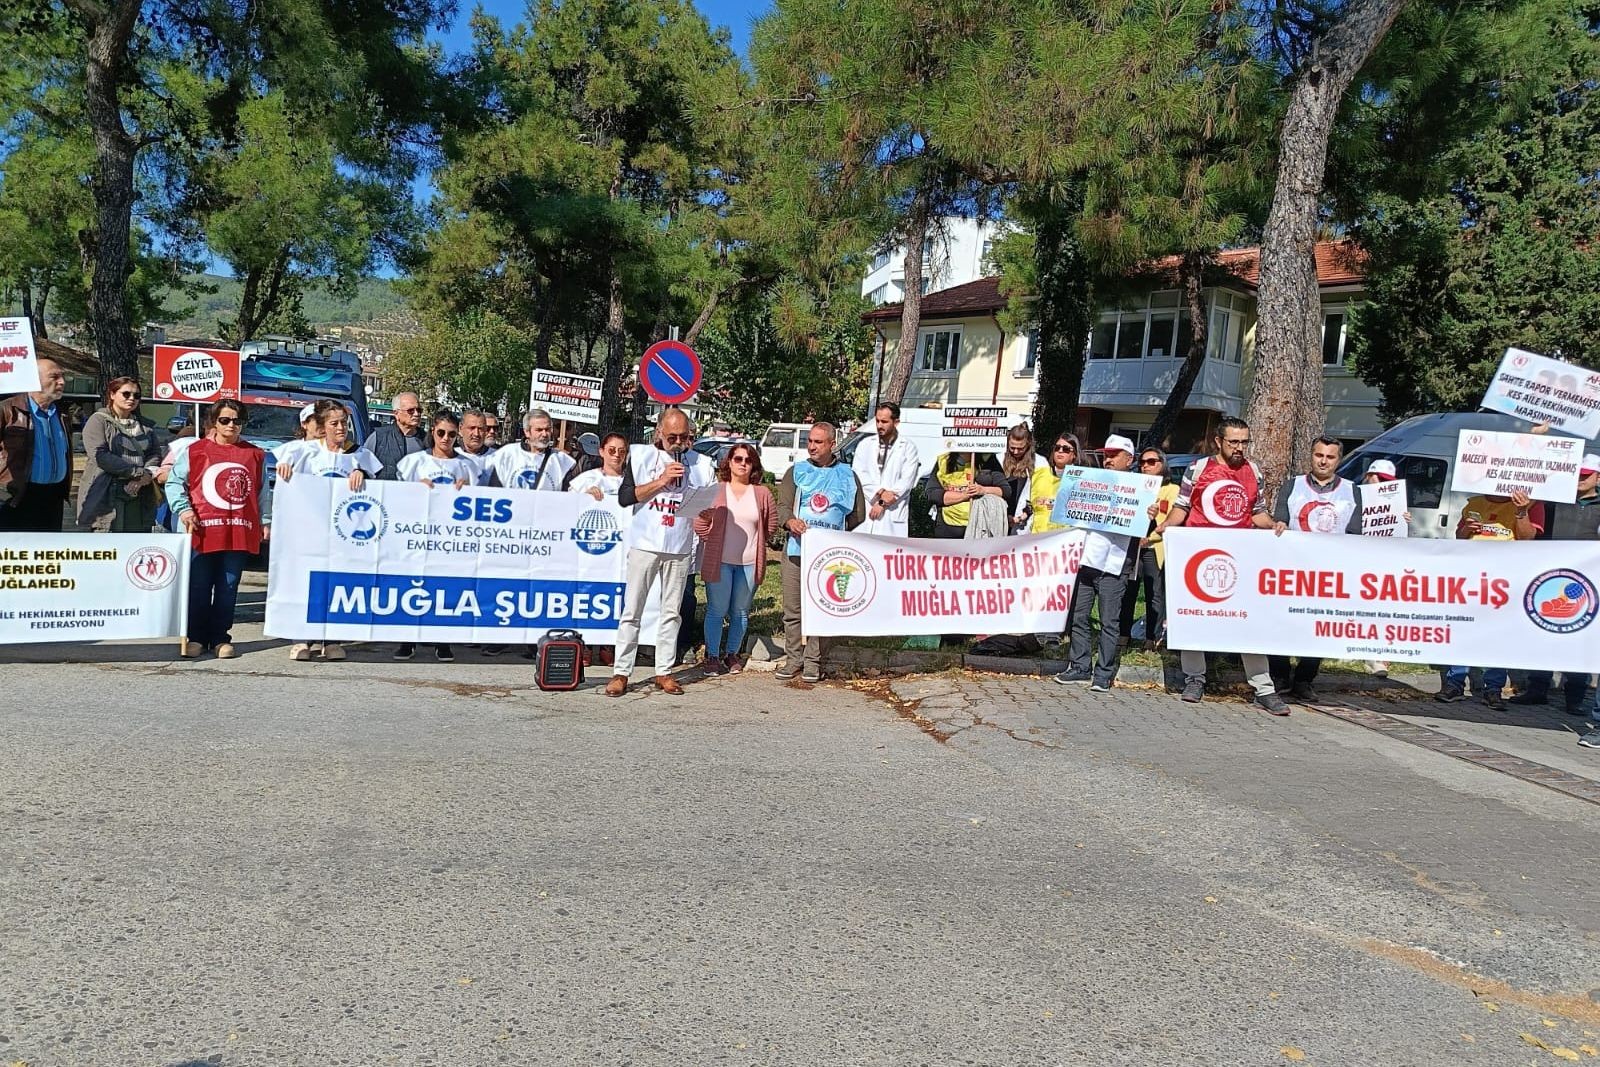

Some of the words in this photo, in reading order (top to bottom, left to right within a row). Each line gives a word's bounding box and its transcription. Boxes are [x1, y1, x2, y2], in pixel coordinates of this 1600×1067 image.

[176, 358, 214, 371] EZİYET
[173, 370, 222, 383] YÖNETMELİĞİNE
[538, 373, 572, 385] VERGİDE
[572, 378, 601, 389] ADALET
[180, 381, 218, 394] HAYIR!
[1498, 373, 1525, 386] SAHTE
[1524, 380, 1552, 395] RAPOR
[535, 392, 550, 401] YENİ
[550, 394, 579, 406] VERGİLER
[1506, 389, 1522, 400] KES
[946, 408, 978, 416] VERGİDE
[979, 409, 1007, 417] ADALET
[943, 428, 958, 436] YENİ
[959, 428, 987, 436] VERGİLER
[1490, 457, 1505, 467] veya
[1486, 469, 1498, 479] KES
[1378, 483, 1399, 493] AHEF
[452, 496, 513, 524] SES
[1370, 514, 1399, 527] DEĞİL
[394, 521, 442, 536] SAĞLIK
[446, 525, 461, 537] VE
[466, 526, 515, 539] SOSYAL
[519, 527, 565, 542] HİZMET
[570, 527, 623, 542] KESK
[0, 547, 29, 560] İLE
[34, 547, 117, 560] HEKİMLERİ
[406, 539, 481, 554] EMEKÇİLERİ
[485, 541, 551, 556] SENDİKASI
[0, 562, 61, 575] ERNEĞİ
[883, 549, 928, 581] TÜRK
[932, 548, 1018, 581] TABİPLERİ
[1258, 568, 1350, 599] GENEL
[1360, 568, 1510, 610] SAĞLIK-İŞ
[329, 579, 482, 617] MUĞLA
[494, 586, 623, 625] ŞUBESİ
[901, 584, 961, 617] MUĞLA
[965, 583, 1015, 615] TABİP
[19, 609, 76, 619] HEKİMLERİ
[79, 607, 140, 618] DERNEKLERİ
[1177, 608, 1205, 617] GENEL
[1335, 609, 1354, 617] Sosyal
[1411, 613, 1443, 621] Çalışanları
[30, 620, 105, 629] FEDERASYONU
[1315, 619, 1378, 640] MUĞLA
[1385, 623, 1450, 645] ŞUBESİ
